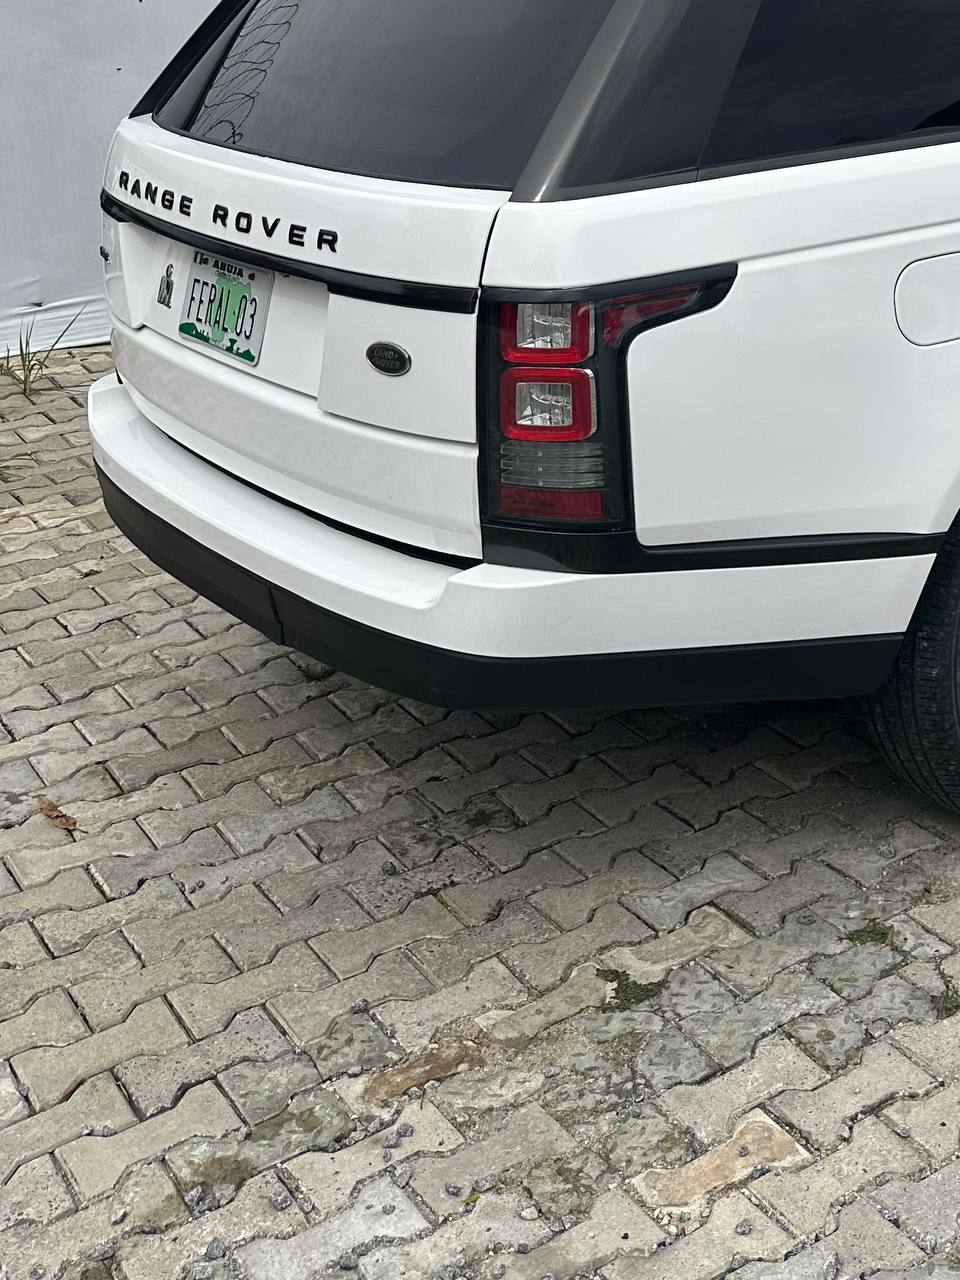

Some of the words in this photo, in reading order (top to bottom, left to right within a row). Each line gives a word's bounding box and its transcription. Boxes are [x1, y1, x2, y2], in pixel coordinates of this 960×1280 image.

[119, 170, 193, 217] RANGE
[212, 204, 338, 253] ROVER
[212, 259, 244, 278] ABUJA
